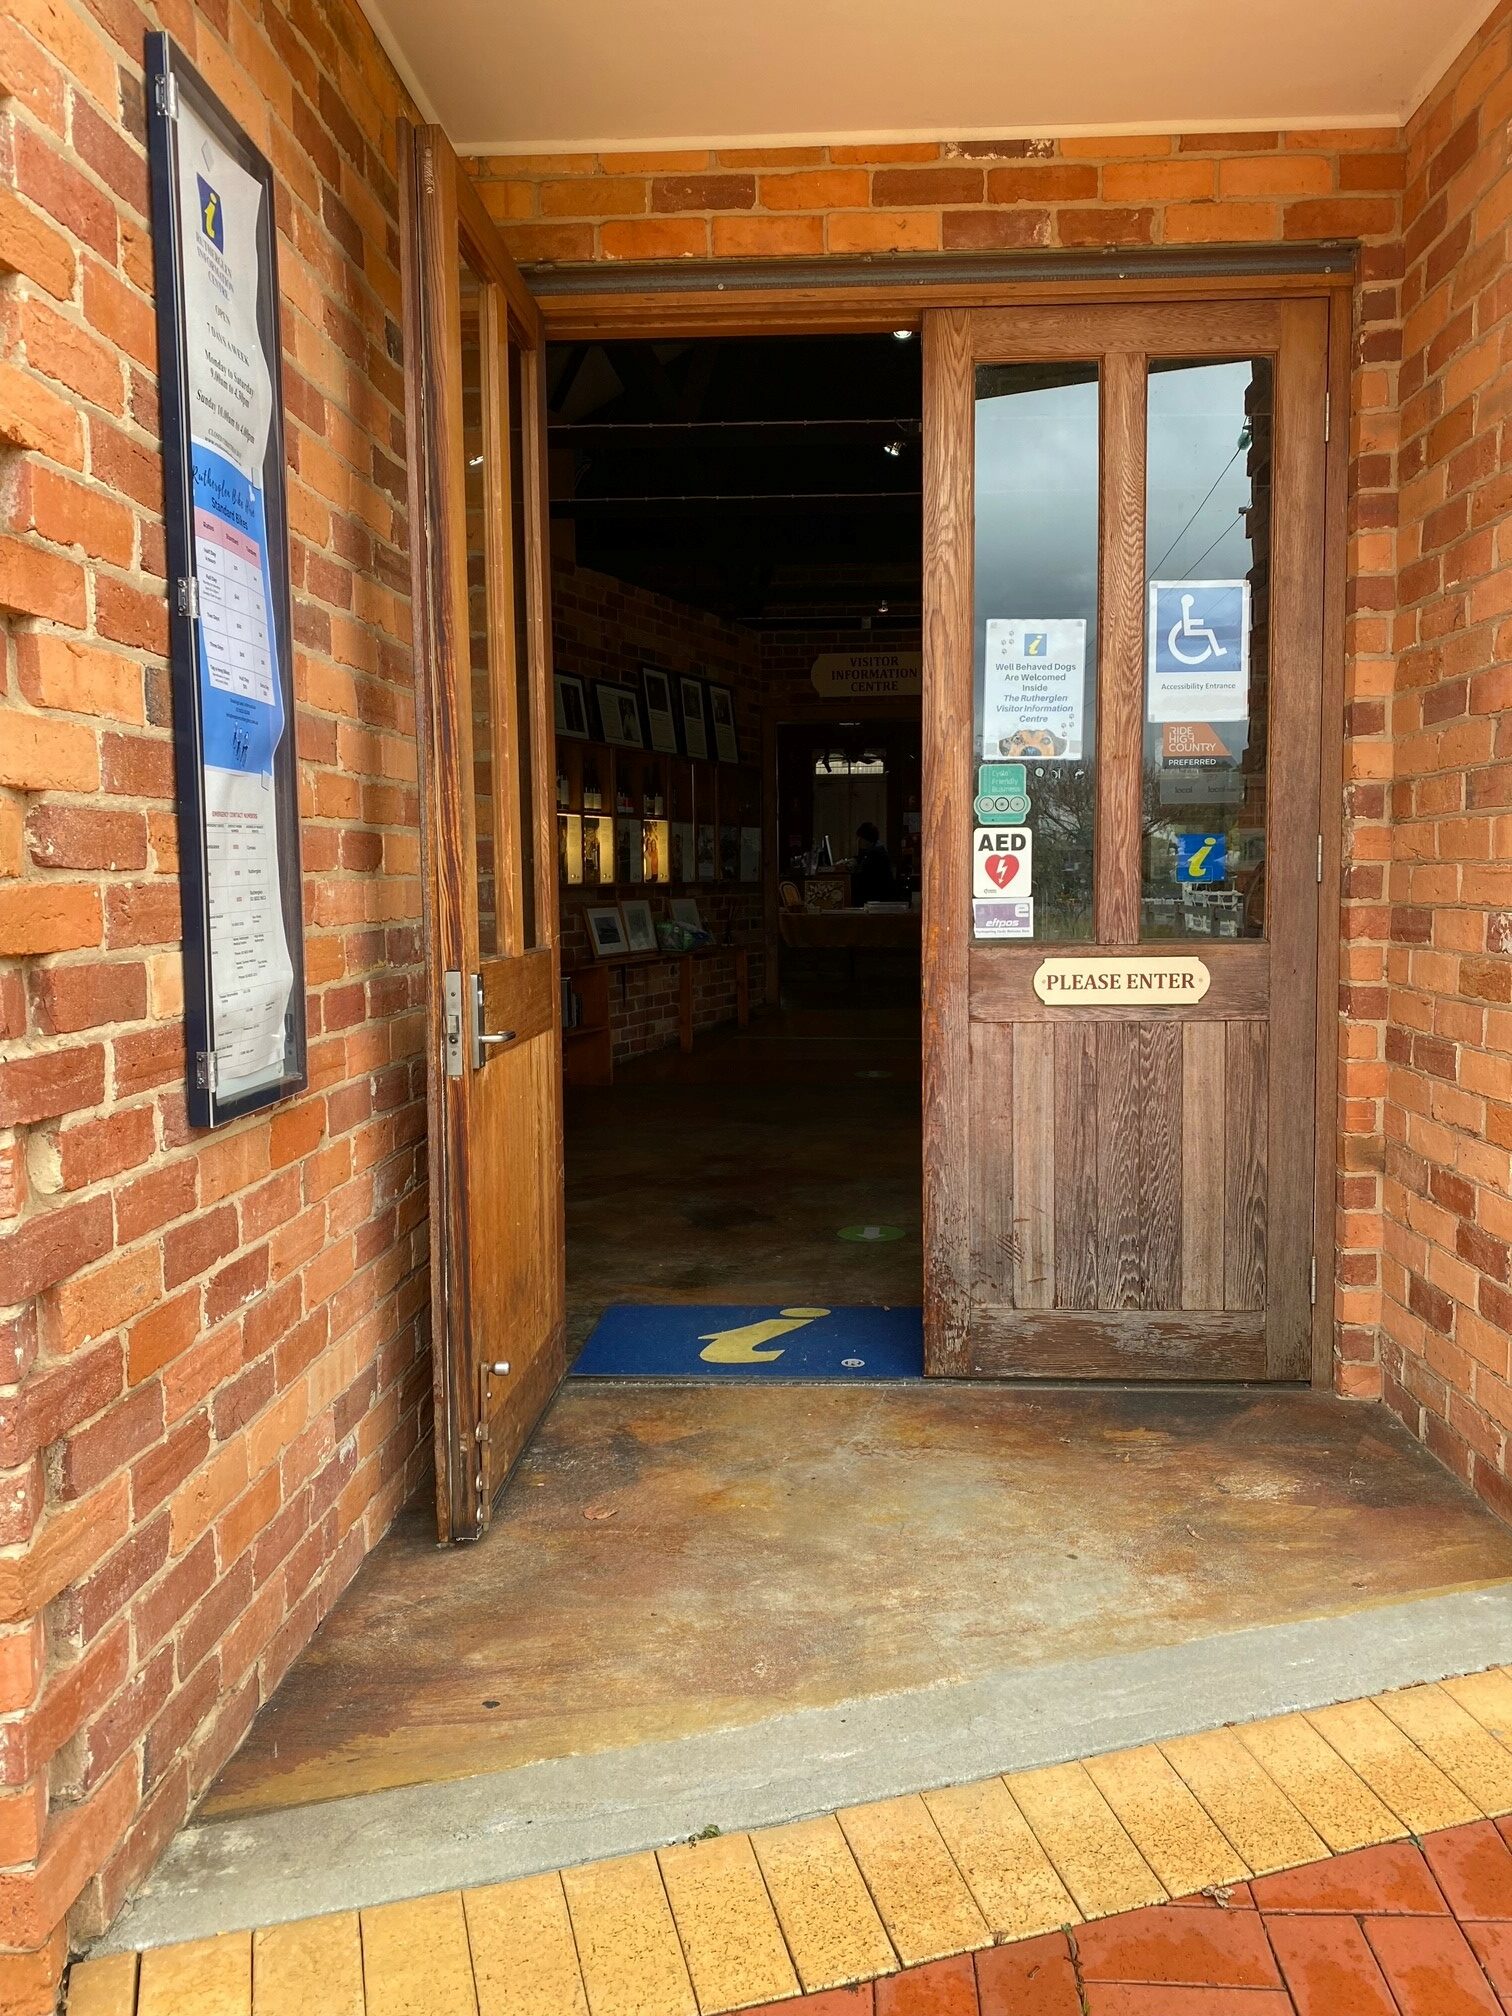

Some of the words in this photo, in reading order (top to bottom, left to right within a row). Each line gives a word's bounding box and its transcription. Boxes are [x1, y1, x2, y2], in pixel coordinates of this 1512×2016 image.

[205, 348, 226, 376] Monday
[234, 372, 254, 398] Saturday
[196, 388, 216, 414] Sunday
[211, 496, 235, 521] Standard
[849, 656, 899, 667] VISITOR
[995, 663, 1014, 671] Well
[1016, 663, 1052, 671] Behaved
[1054, 664, 1076, 672] Dogs
[831, 667, 918, 680] INFORMATION
[1021, 673, 1066, 681] Welcomed
[850, 680, 898, 692] CENTRE
[1004, 694, 1019, 702] The
[1021, 694, 1068, 703] Rutherglen
[1024, 704, 1073, 712] Information
[1168, 726, 1194, 735] RIDE
[1168, 743, 1217, 752] COUNTRY
[1168, 758, 1217, 766] PREFERRED
[978, 833, 1026, 852] AED
[985, 918, 1019, 928] eftpos
[1046, 974, 1121, 990] PLEASE
[1126, 973, 1195, 989] ENTER
